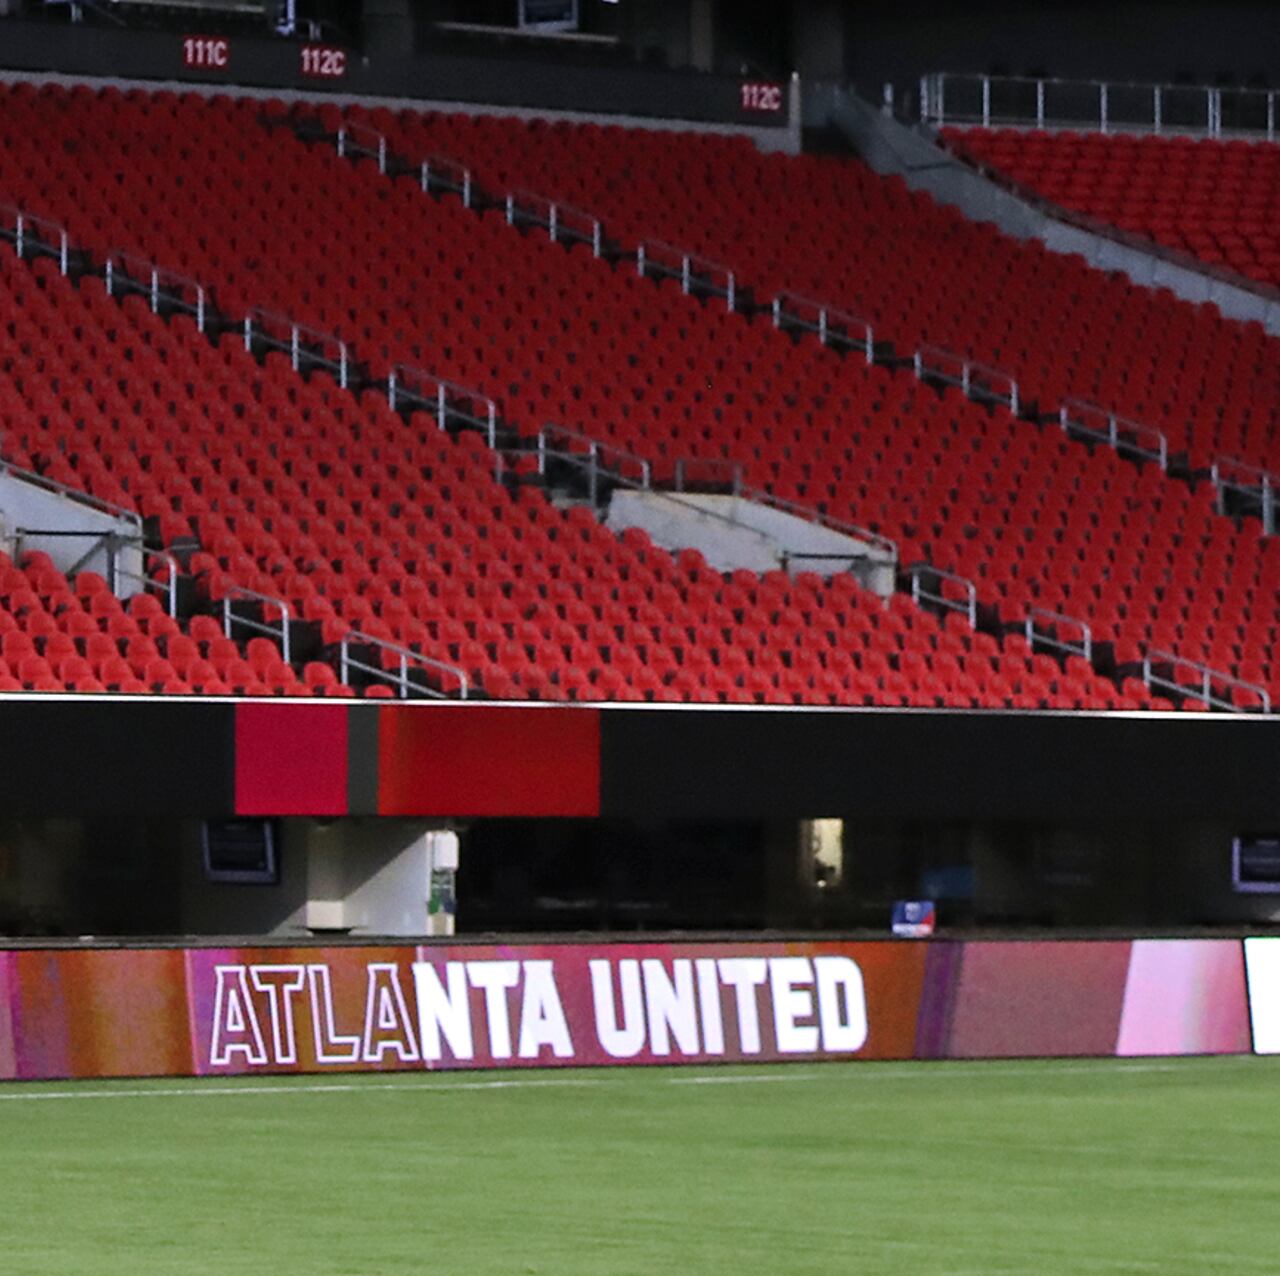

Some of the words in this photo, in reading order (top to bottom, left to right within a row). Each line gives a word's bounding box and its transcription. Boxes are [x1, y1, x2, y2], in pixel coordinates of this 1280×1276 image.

[184, 39, 227, 66] 111C
[301, 48, 344, 75] 112C
[742, 84, 781, 110] 112C
[210, 961, 574, 1064] ATLANTA
[588, 956, 869, 1057] UNITED
